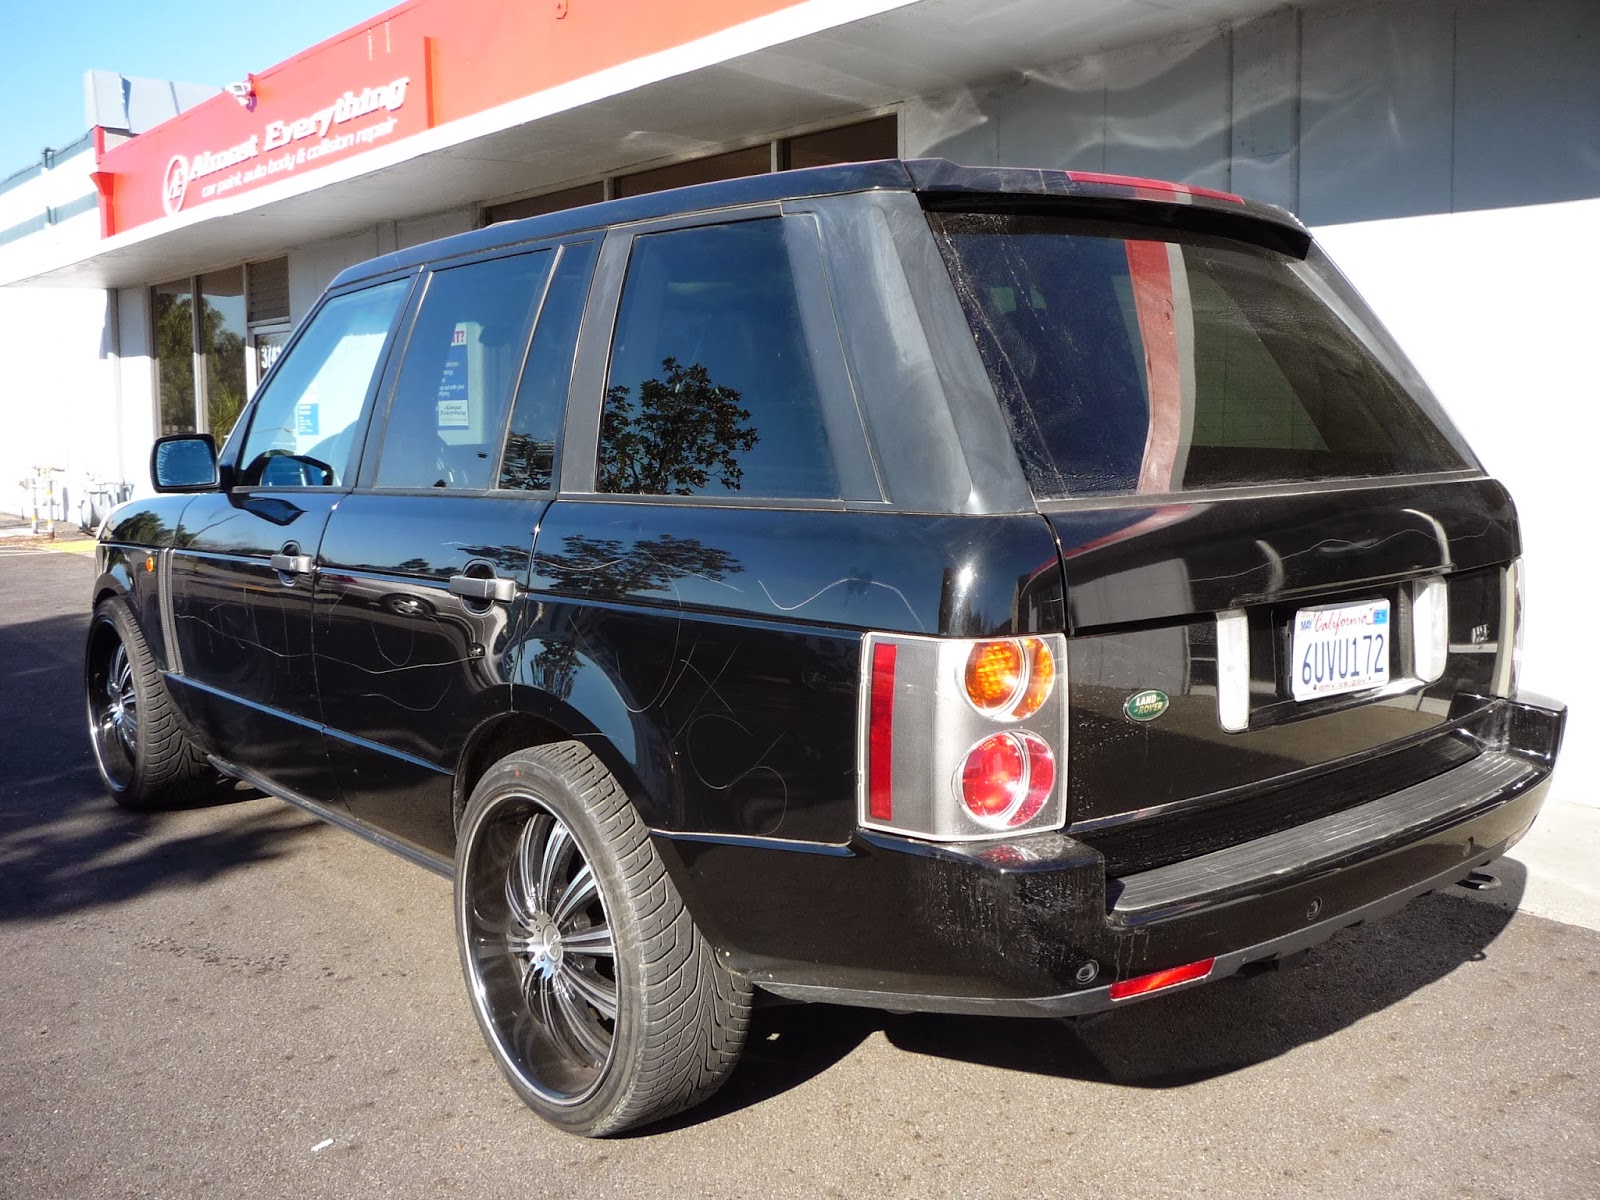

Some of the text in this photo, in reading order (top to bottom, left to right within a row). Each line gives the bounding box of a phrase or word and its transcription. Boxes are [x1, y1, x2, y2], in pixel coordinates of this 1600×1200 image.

[189, 77, 410, 181] Almost Everything
[267, 153, 296, 175] body
[355, 116, 398, 143] repair
[1300, 619, 1312, 631] MAY
[1315, 611, 1374, 636] California
[1302, 634, 1384, 685] 6UVU172
[1136, 694, 1157, 706] LAND
[1138, 701, 1163, 714] ROVER
